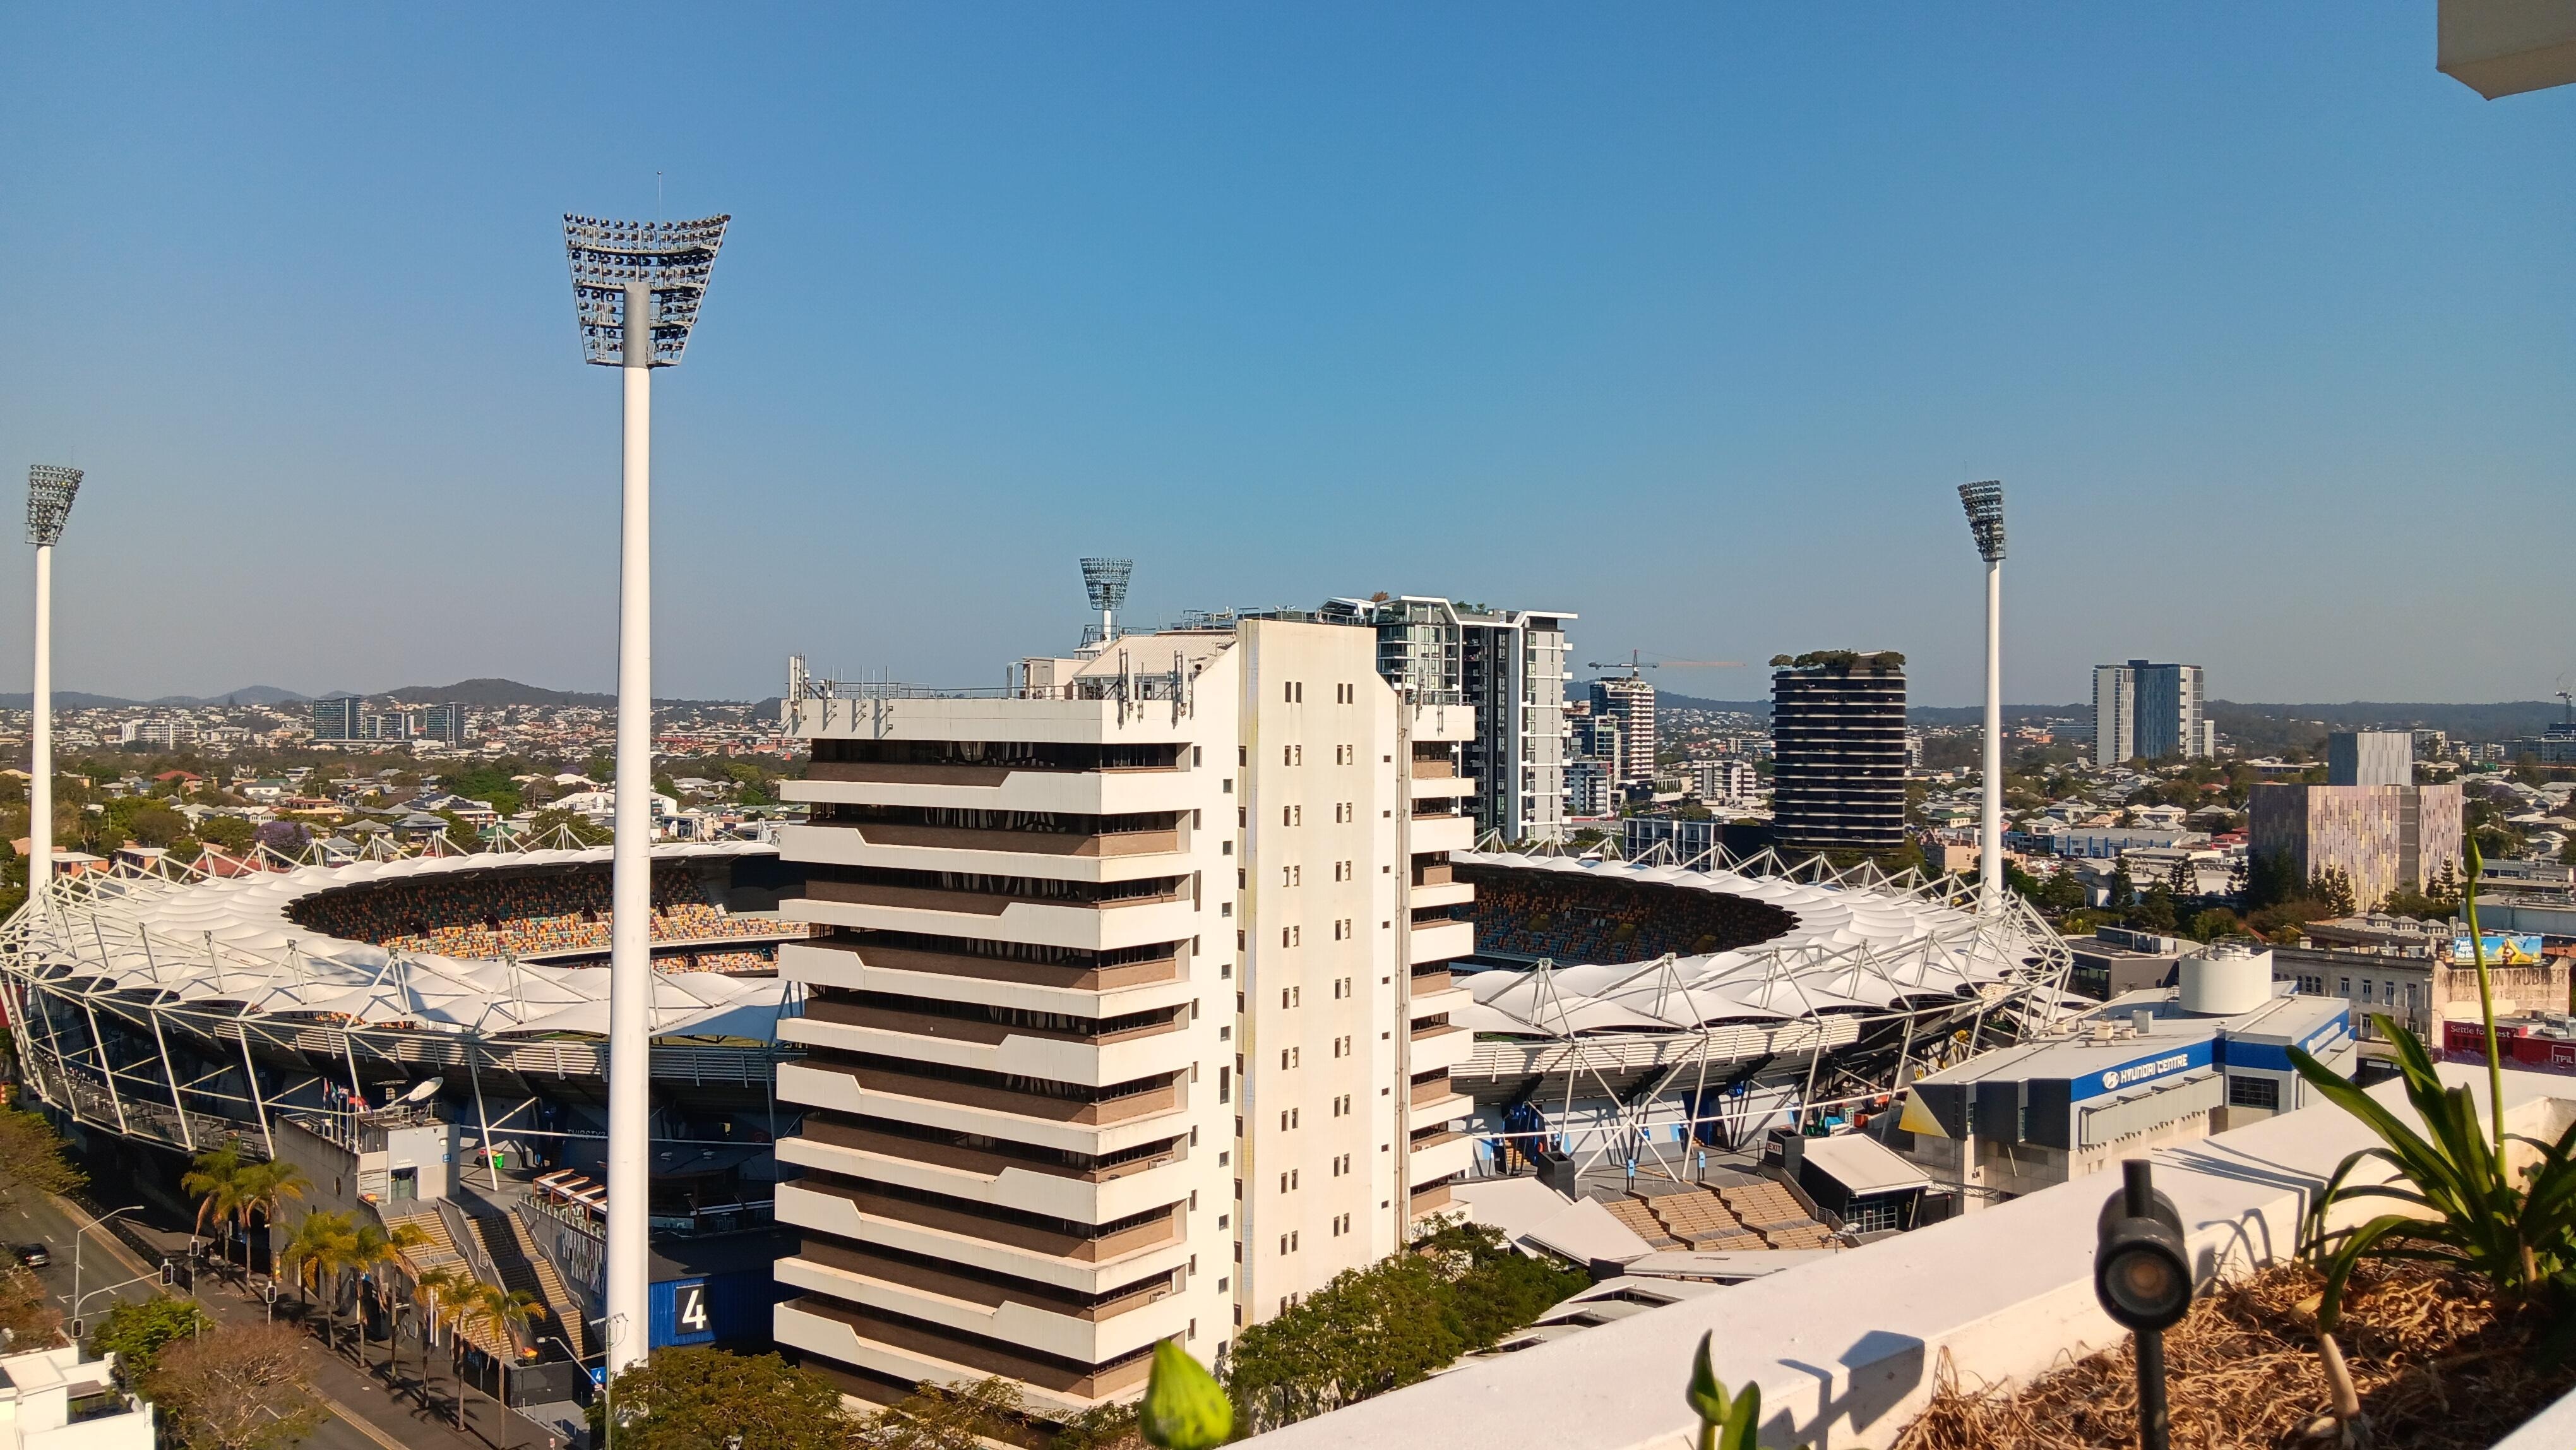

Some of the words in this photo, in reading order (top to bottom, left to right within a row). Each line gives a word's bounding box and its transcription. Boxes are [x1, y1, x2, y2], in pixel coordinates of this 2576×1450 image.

[2450, 1026, 2474, 1034] Settle
[2120, 1062, 2156, 1084] HYUNDAI
[2156, 1053, 2188, 1074] CENTRE
[1768, 1142, 1781, 1153] EXIT
[682, 1289, 707, 1329] 4
[595, 1370, 602, 1381] 4
